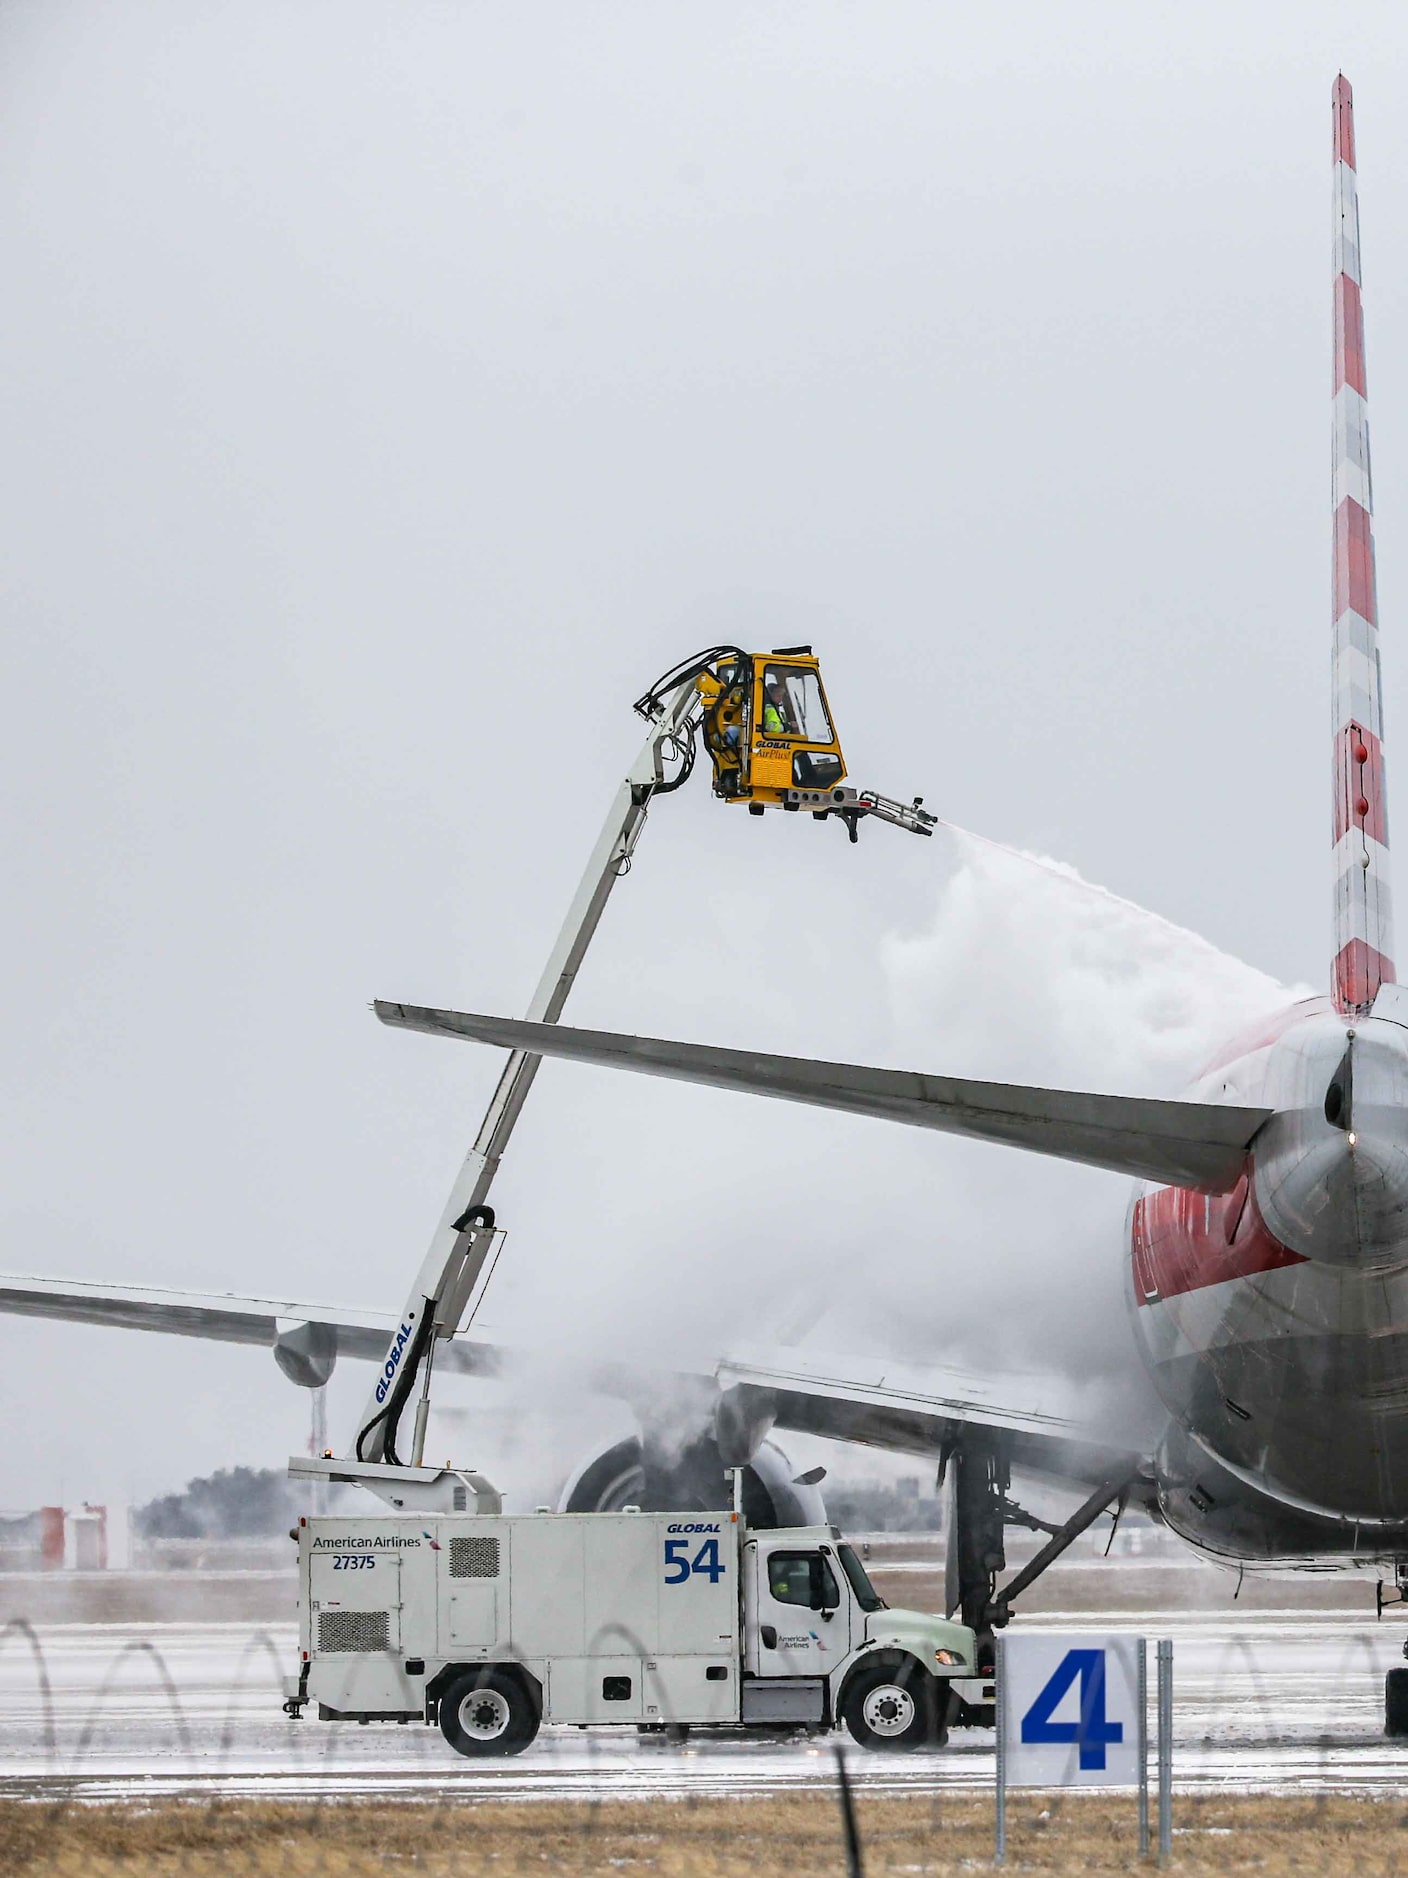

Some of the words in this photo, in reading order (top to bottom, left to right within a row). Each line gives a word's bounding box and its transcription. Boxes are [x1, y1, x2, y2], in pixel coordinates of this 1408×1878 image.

[756, 740, 791, 750] GLOBAL
[375, 1323, 413, 1404] GLOBAL
[667, 1523, 721, 1533] GLOBAL
[313, 1536, 373, 1548] American
[374, 1536, 421, 1548] Airlines
[333, 1556, 375, 1570] 27375
[664, 1539, 726, 1585] 54
[784, 1641, 810, 1649] Airlines
[1021, 1649, 1123, 1770] 4
